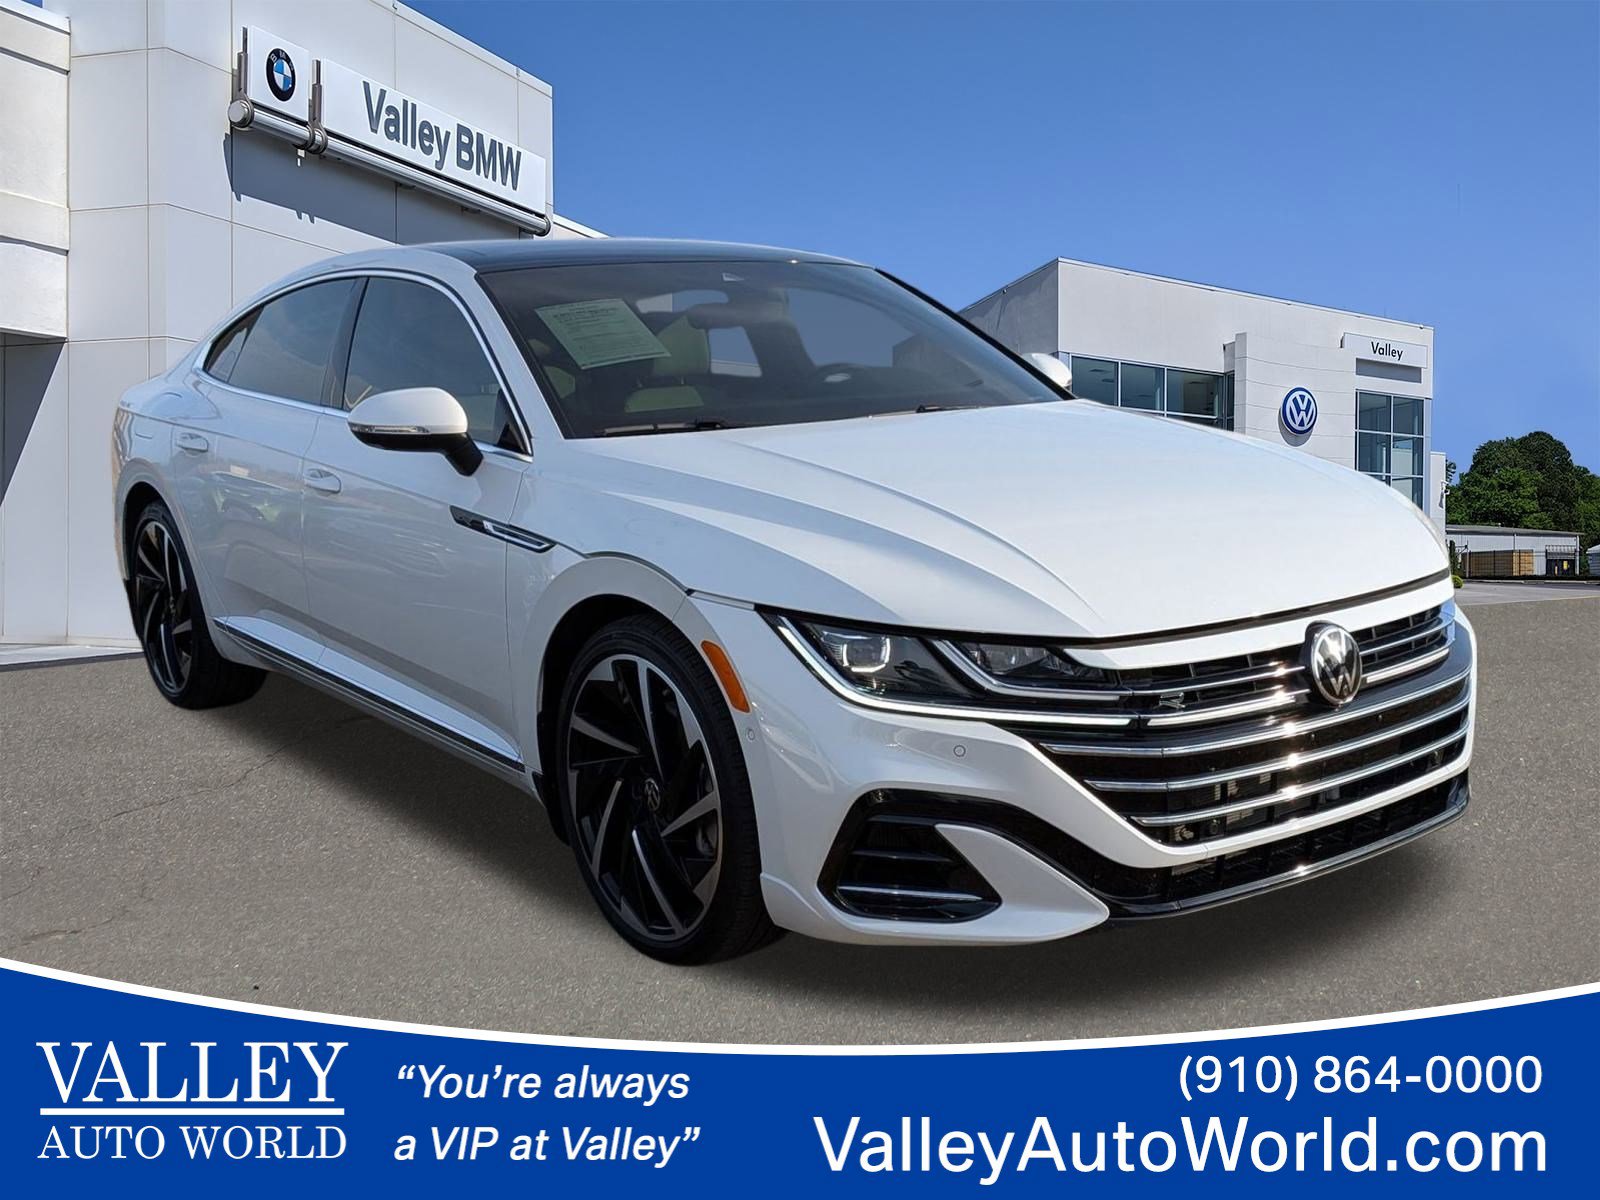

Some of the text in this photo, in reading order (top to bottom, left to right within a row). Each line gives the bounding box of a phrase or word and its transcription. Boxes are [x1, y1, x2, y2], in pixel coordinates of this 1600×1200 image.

[362, 80, 522, 191] Valley BMW
[1371, 341, 1403, 361] Valley
